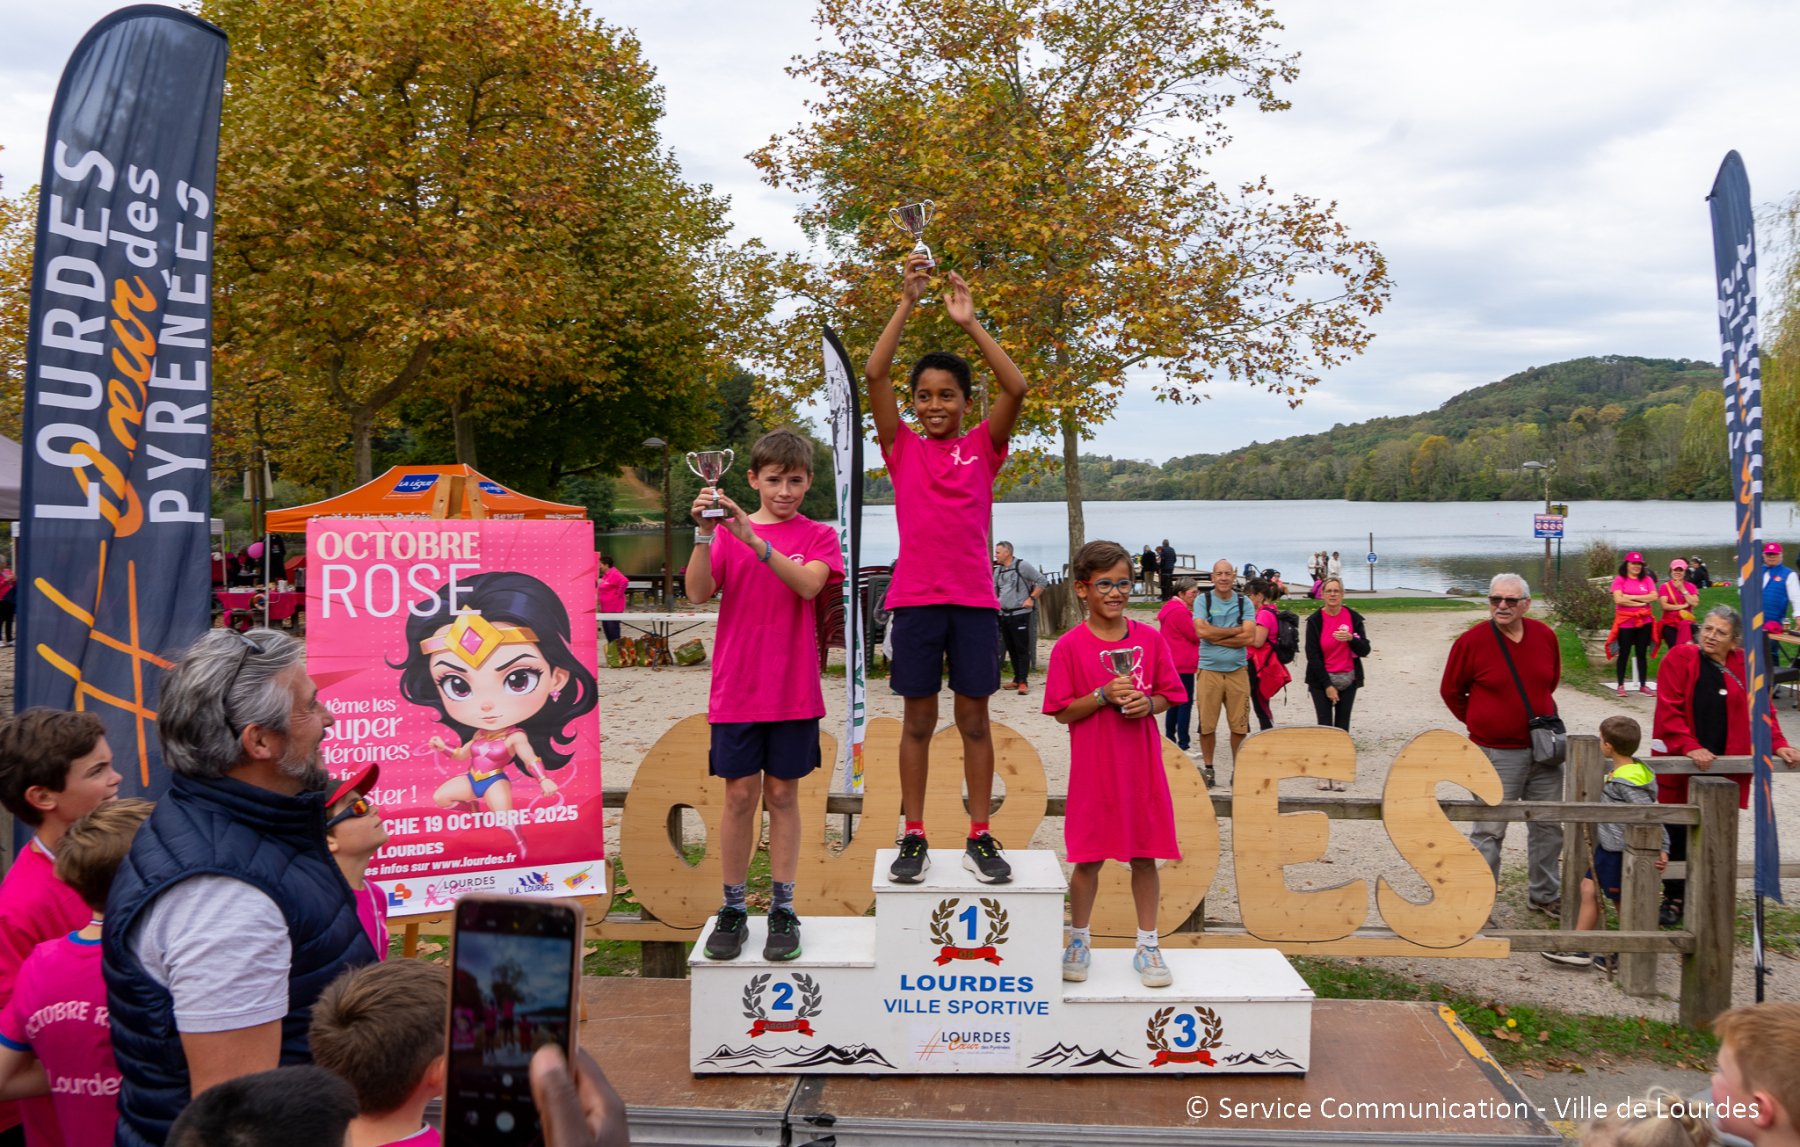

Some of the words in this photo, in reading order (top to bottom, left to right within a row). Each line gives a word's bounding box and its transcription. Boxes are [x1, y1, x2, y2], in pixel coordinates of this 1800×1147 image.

[109, 164, 160, 268] des
[34, 139, 115, 520] LOURDES
[316, 531, 481, 560] OCTOBRE
[322, 563, 482, 619] ROSE
[372, 698, 396, 713] les
[423, 815, 443, 833] 19
[447, 809, 531, 831] OCTOBRE
[534, 804, 579, 824] 2025
[376, 841, 444, 859] LOURDES
[379, 862, 409, 876] infos
[410, 862, 430, 873] sur
[432, 852, 517, 870] www.lourdes.fr
[443, 875, 496, 889] LOURDES
[958, 905, 978, 940] 1
[957, 950, 976, 959] OR
[771, 982, 793, 1010] 2
[900, 974, 1034, 993] LOURDES
[883, 998, 941, 1014] VILLE
[947, 1000, 1050, 1016] SPORTIVE
[763, 1022, 800, 1030] ARGENT
[942, 1031, 1011, 1043] LOURDES
[1173, 1013, 1196, 1048] 3
[46, 1070, 123, 1097] Lourde
